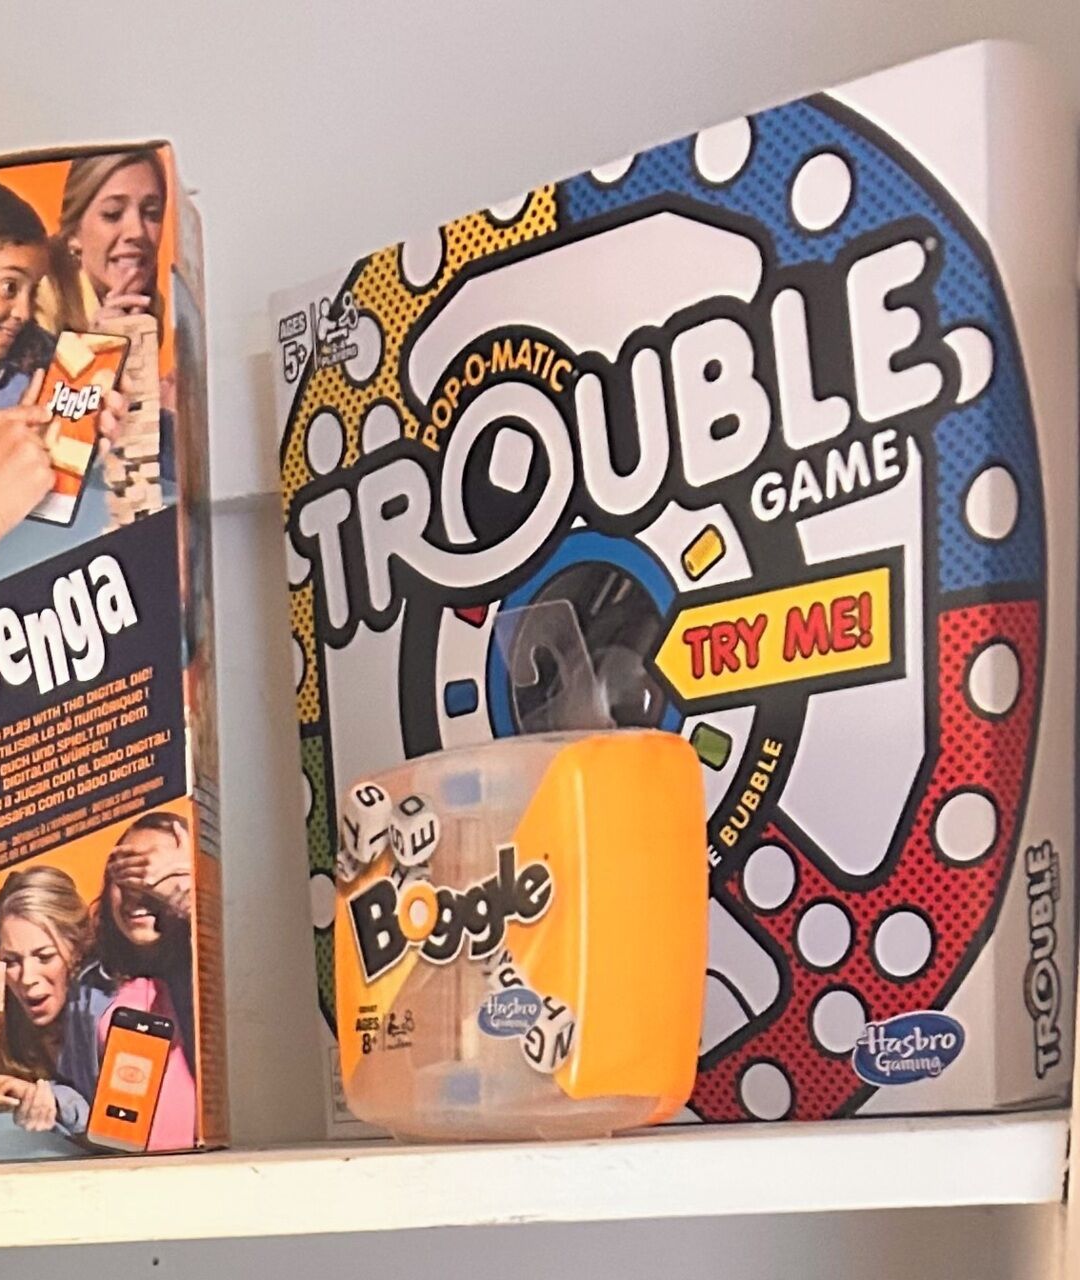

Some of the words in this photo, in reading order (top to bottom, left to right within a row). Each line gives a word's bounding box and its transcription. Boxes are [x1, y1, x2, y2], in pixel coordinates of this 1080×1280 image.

[46, 380, 100, 420] Jenga
[301, 240, 942, 628] TROUBLE
[422, 339, 571, 451] POP-O-MATIC
[751, 435, 900, 522] GAME
[683, 620, 769, 680] TRY
[784, 592, 873, 658] ME!
[720, 737, 784, 849] BUBBLE
[350, 845, 552, 980] Boggle
[1025, 840, 1062, 1079] TROUBLE
[859, 1018, 956, 1056] Hasbro
[875, 1052, 944, 1079] Gaming
